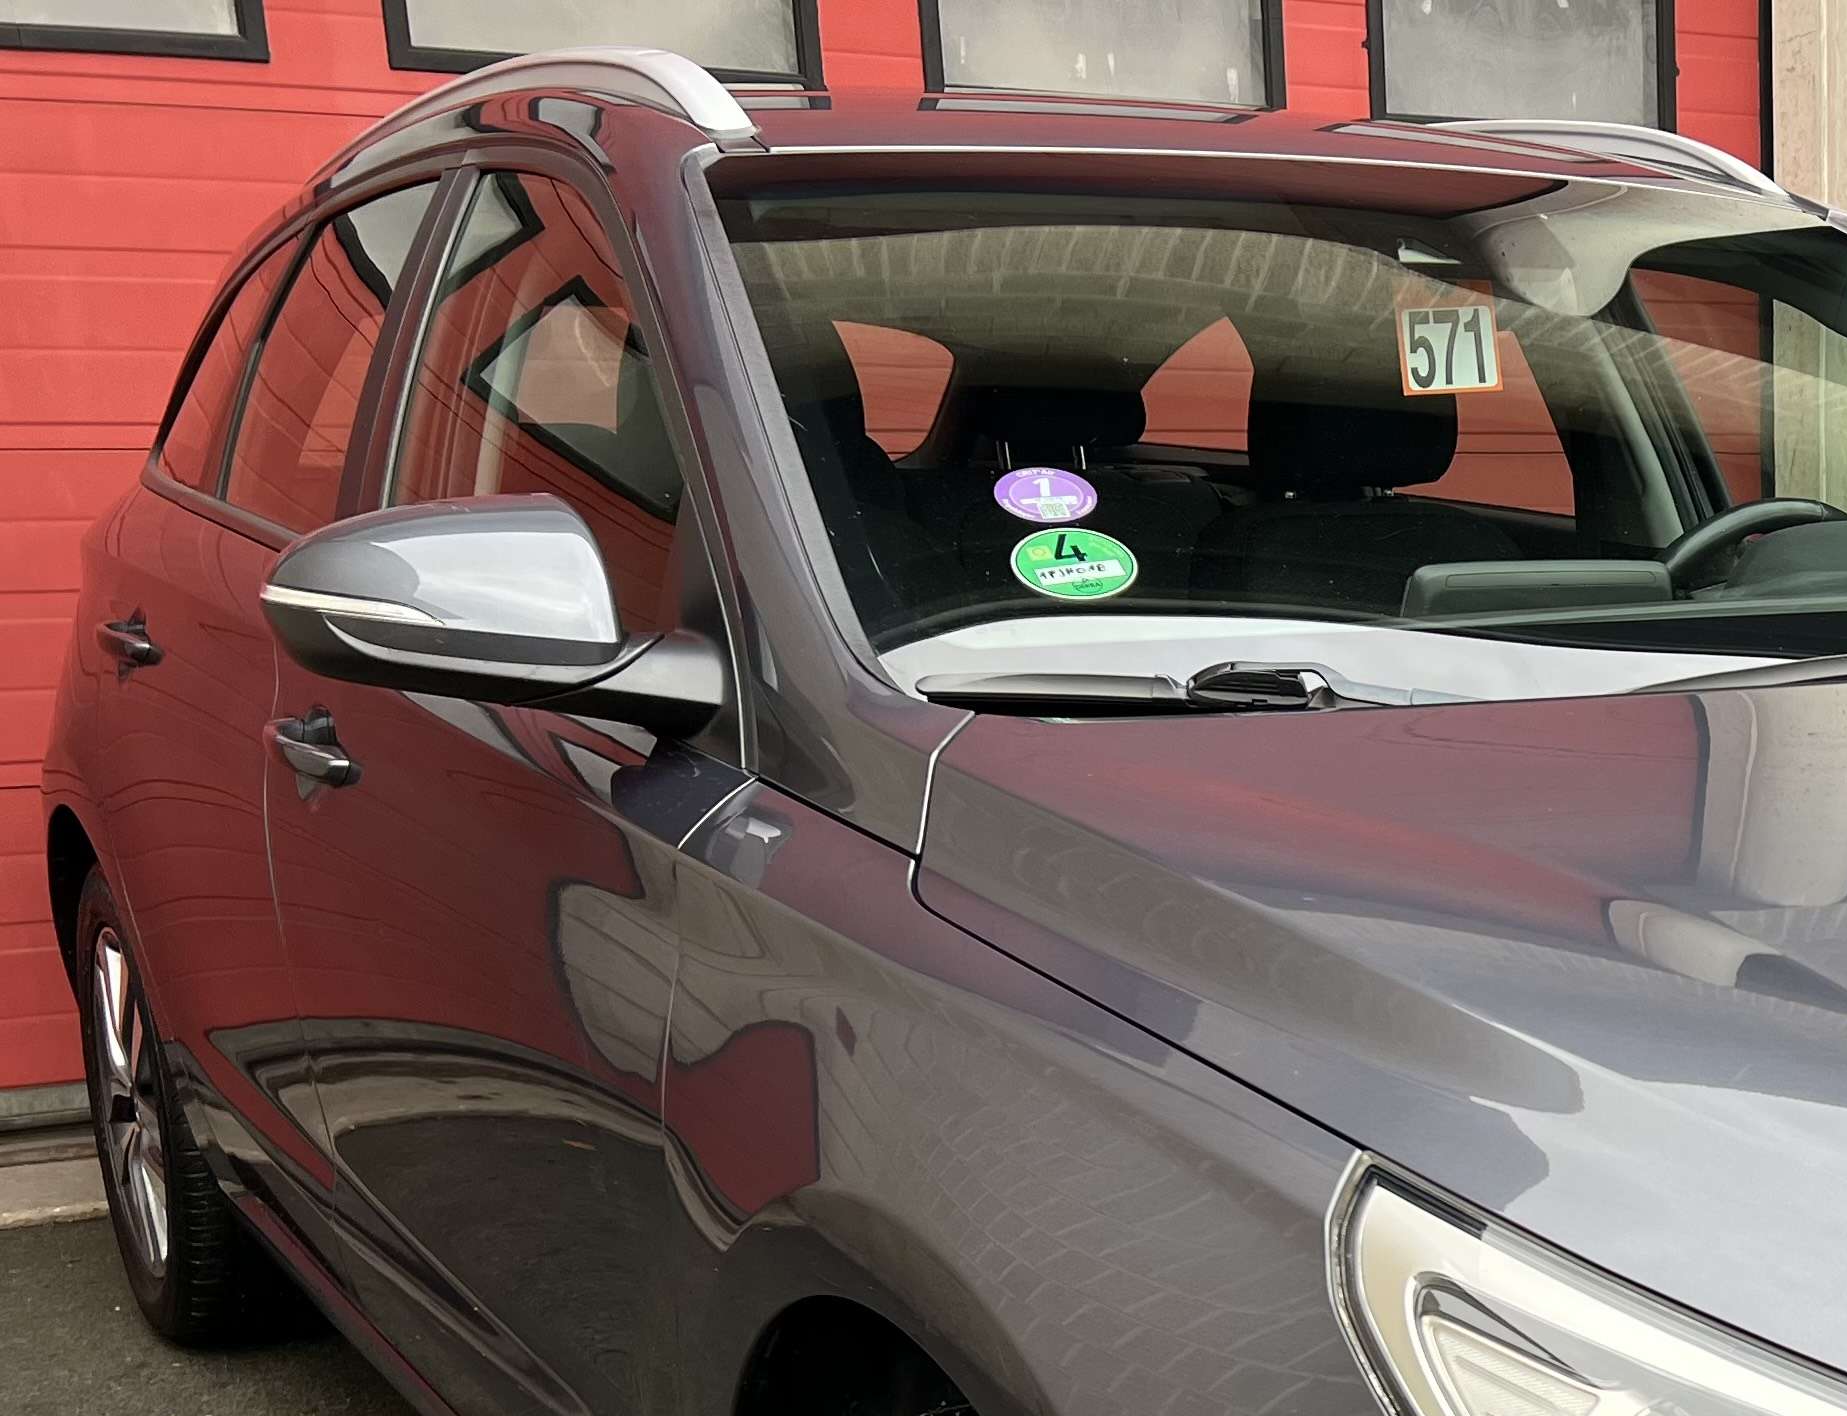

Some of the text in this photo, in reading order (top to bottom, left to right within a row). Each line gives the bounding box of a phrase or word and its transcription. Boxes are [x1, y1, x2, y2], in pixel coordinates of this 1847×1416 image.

[1408, 308, 1487, 388] 571
[1032, 477, 1051, 498] 1
[1054, 533, 1087, 562] 4
